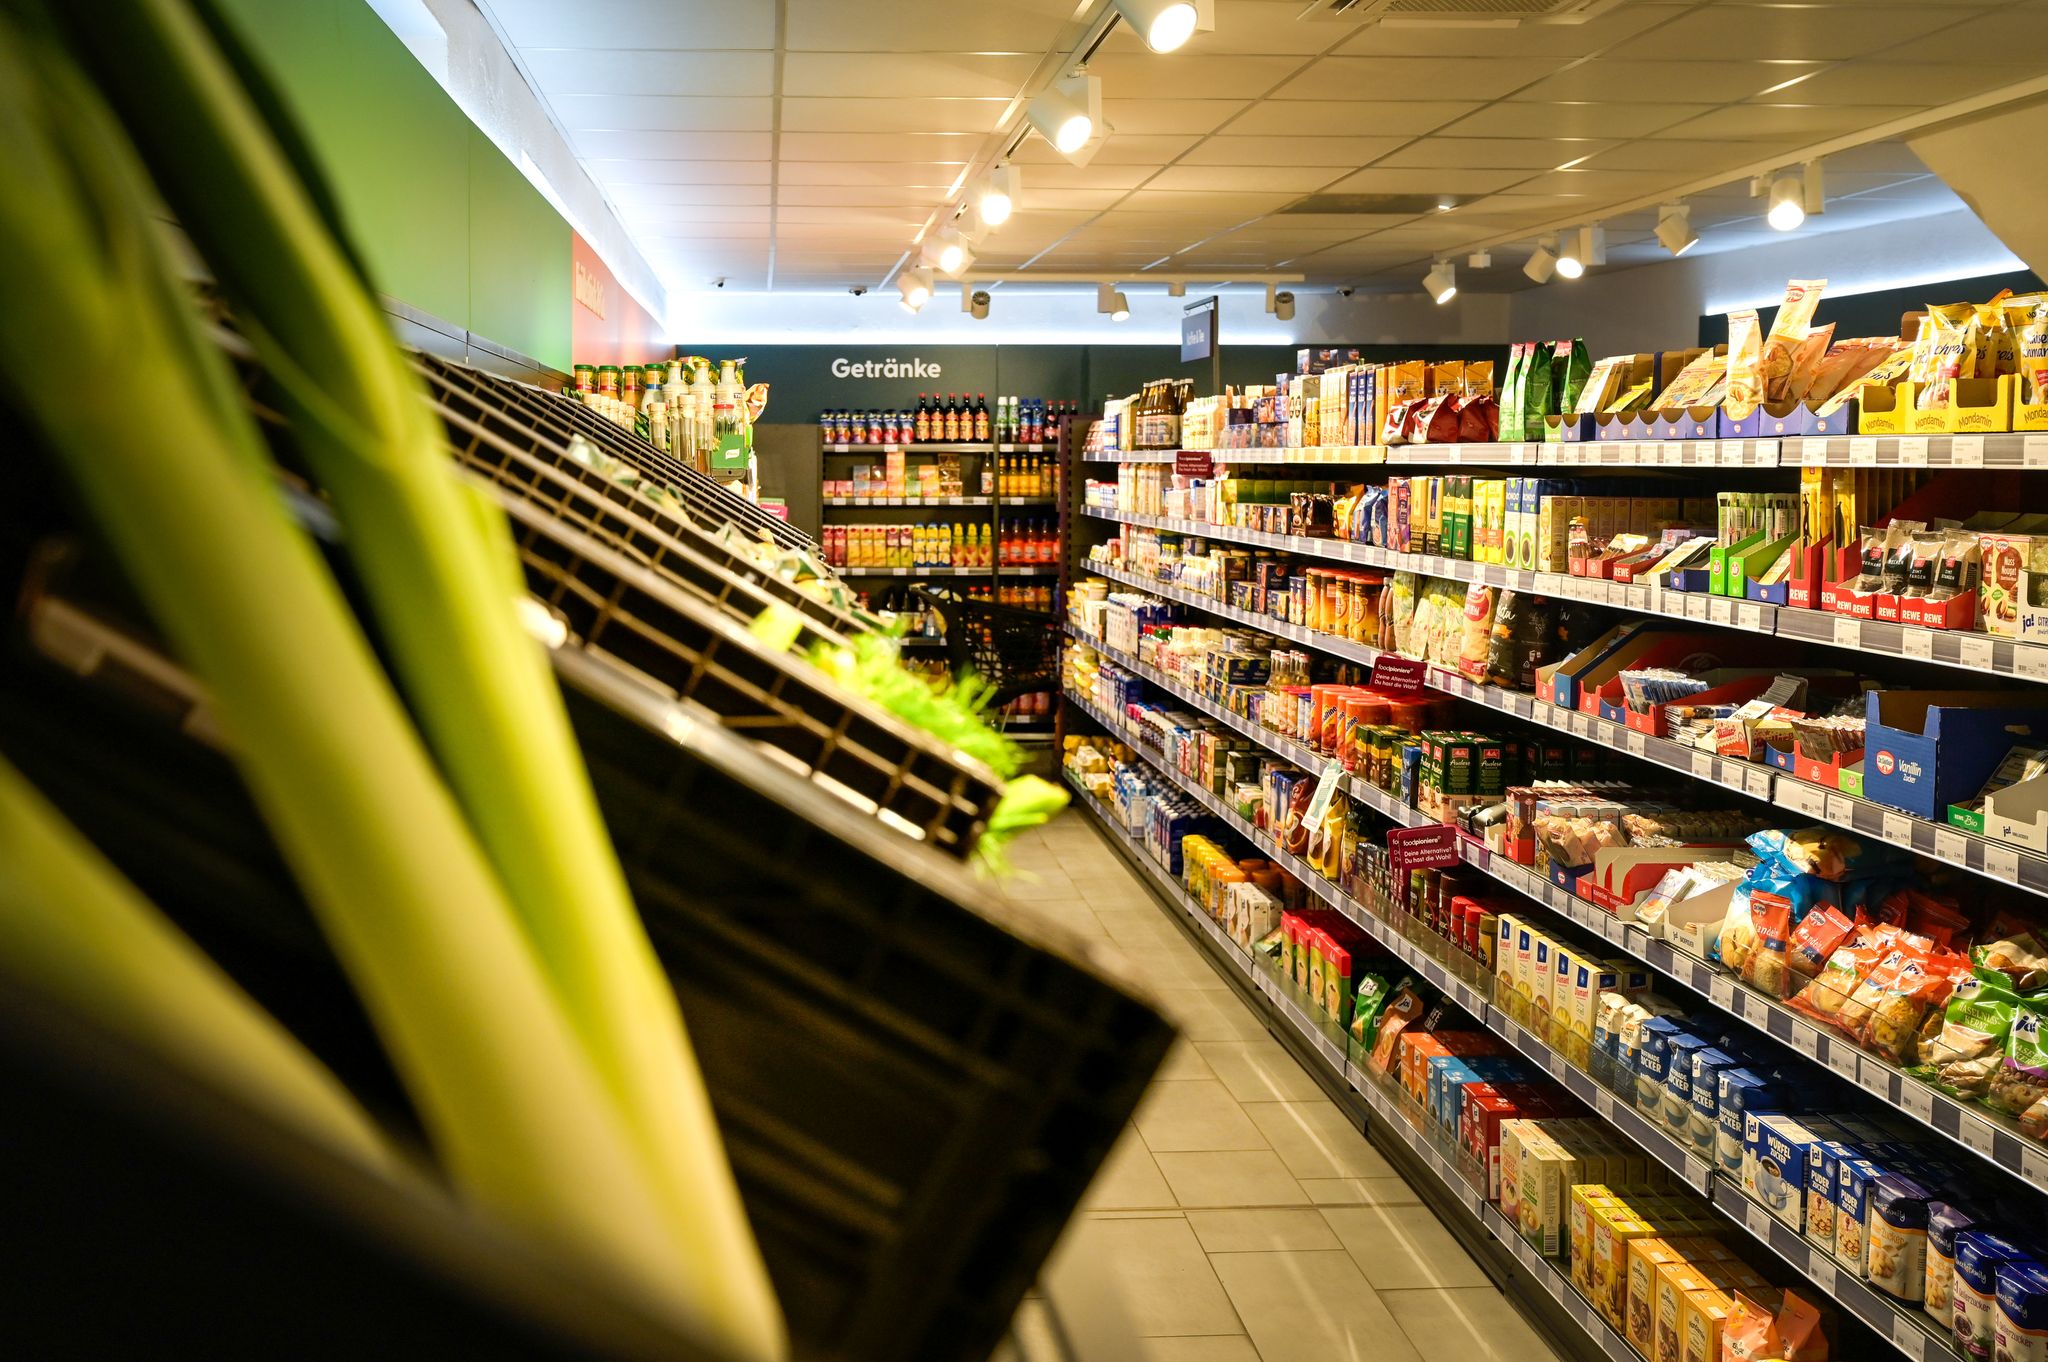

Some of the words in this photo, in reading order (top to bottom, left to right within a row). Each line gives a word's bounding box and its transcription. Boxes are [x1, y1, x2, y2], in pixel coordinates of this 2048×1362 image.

[831, 358, 941, 378] Getränke
[1865, 417, 1895, 432] Mondamin
[1915, 414, 1946, 430] Mondamin
[1958, 412, 1992, 430] Mondamin
[2004, 556, 2015, 566] Nuss
[1614, 567, 1630, 578] REWE
[1789, 588, 1808, 601] REWE
[1822, 592, 1836, 604] REW
[1852, 604, 1870, 615] REWE
[1878, 607, 1896, 618] REWE
[1902, 610, 1920, 622] REWE
[1924, 612, 1942, 624] REWE
[2022, 613, 2035, 634] ja!
[1376, 673, 1390, 681] Deine
[1391, 674, 1420, 684] Alternative?
[1898, 758, 1922, 777] Vanillin
[1902, 773, 1916, 784] Zucker
[1964, 814, 1978, 828] Bio
[2002, 826, 2012, 838] ja!
[1404, 850, 1419, 858] Deine
[1420, 847, 1452, 855] Alternative?
[1500, 940, 1511, 949] Diamant
[1517, 950, 1530, 960] Diamant
[1536, 962, 1548, 972] Diamant
[1556, 974, 1570, 986] Diamant
[1574, 987, 1588, 998] Diamant
[1747, 1119, 1756, 1137] ja!
[1767, 1134, 1791, 1160] WÜRFEL
[1770, 1148, 1786, 1165] ZUCKER
[1811, 1149, 1821, 1162] ja!
[1811, 1169, 1830, 1189] PUDER
[1841, 1169, 1850, 1182] ja!
[1812, 1180, 1828, 1196] ZUCKER
[1841, 1188, 1858, 1209] PUDER
[1842, 1200, 1856, 1216] ZUCKER
